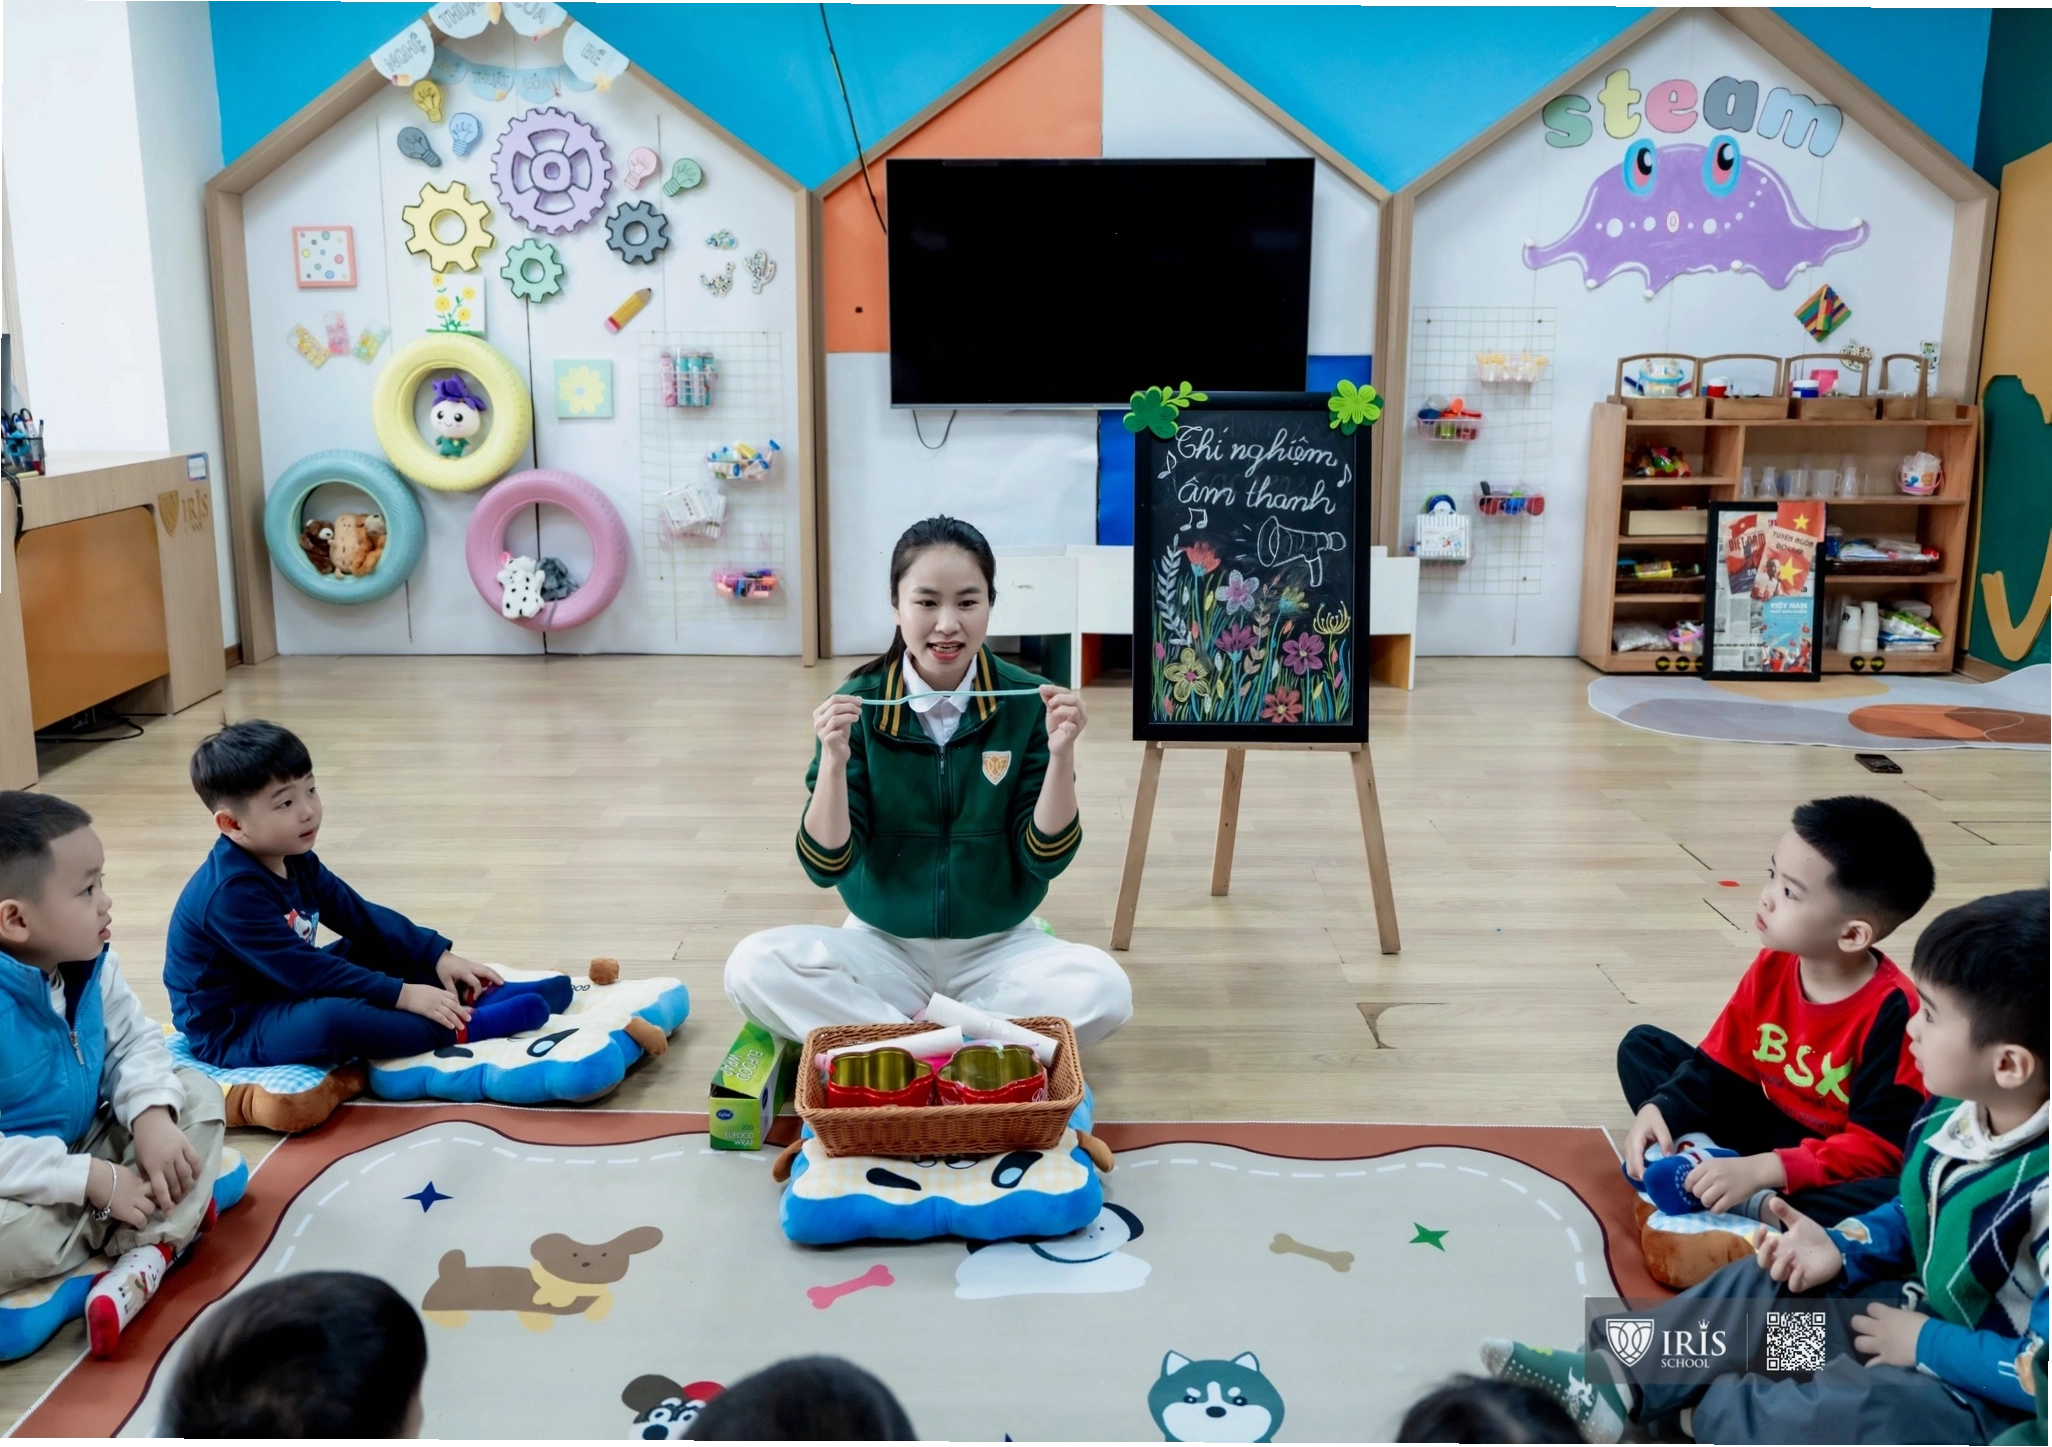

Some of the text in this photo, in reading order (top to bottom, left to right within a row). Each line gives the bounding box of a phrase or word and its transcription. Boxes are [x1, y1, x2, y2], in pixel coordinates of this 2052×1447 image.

[383, 32, 427, 72] NGHỆ
[1542, 68, 1843, 157] steam
[1175, 425, 1338, 478] Thí nghiệm
[1177, 476, 1236, 507] âm
[1246, 475, 1336, 514] thanh
[719, 1053, 743, 1077] WRAP
[736, 1049, 764, 1081] EUFOOD
[724, 1131, 755, 1139] EUFOOD
